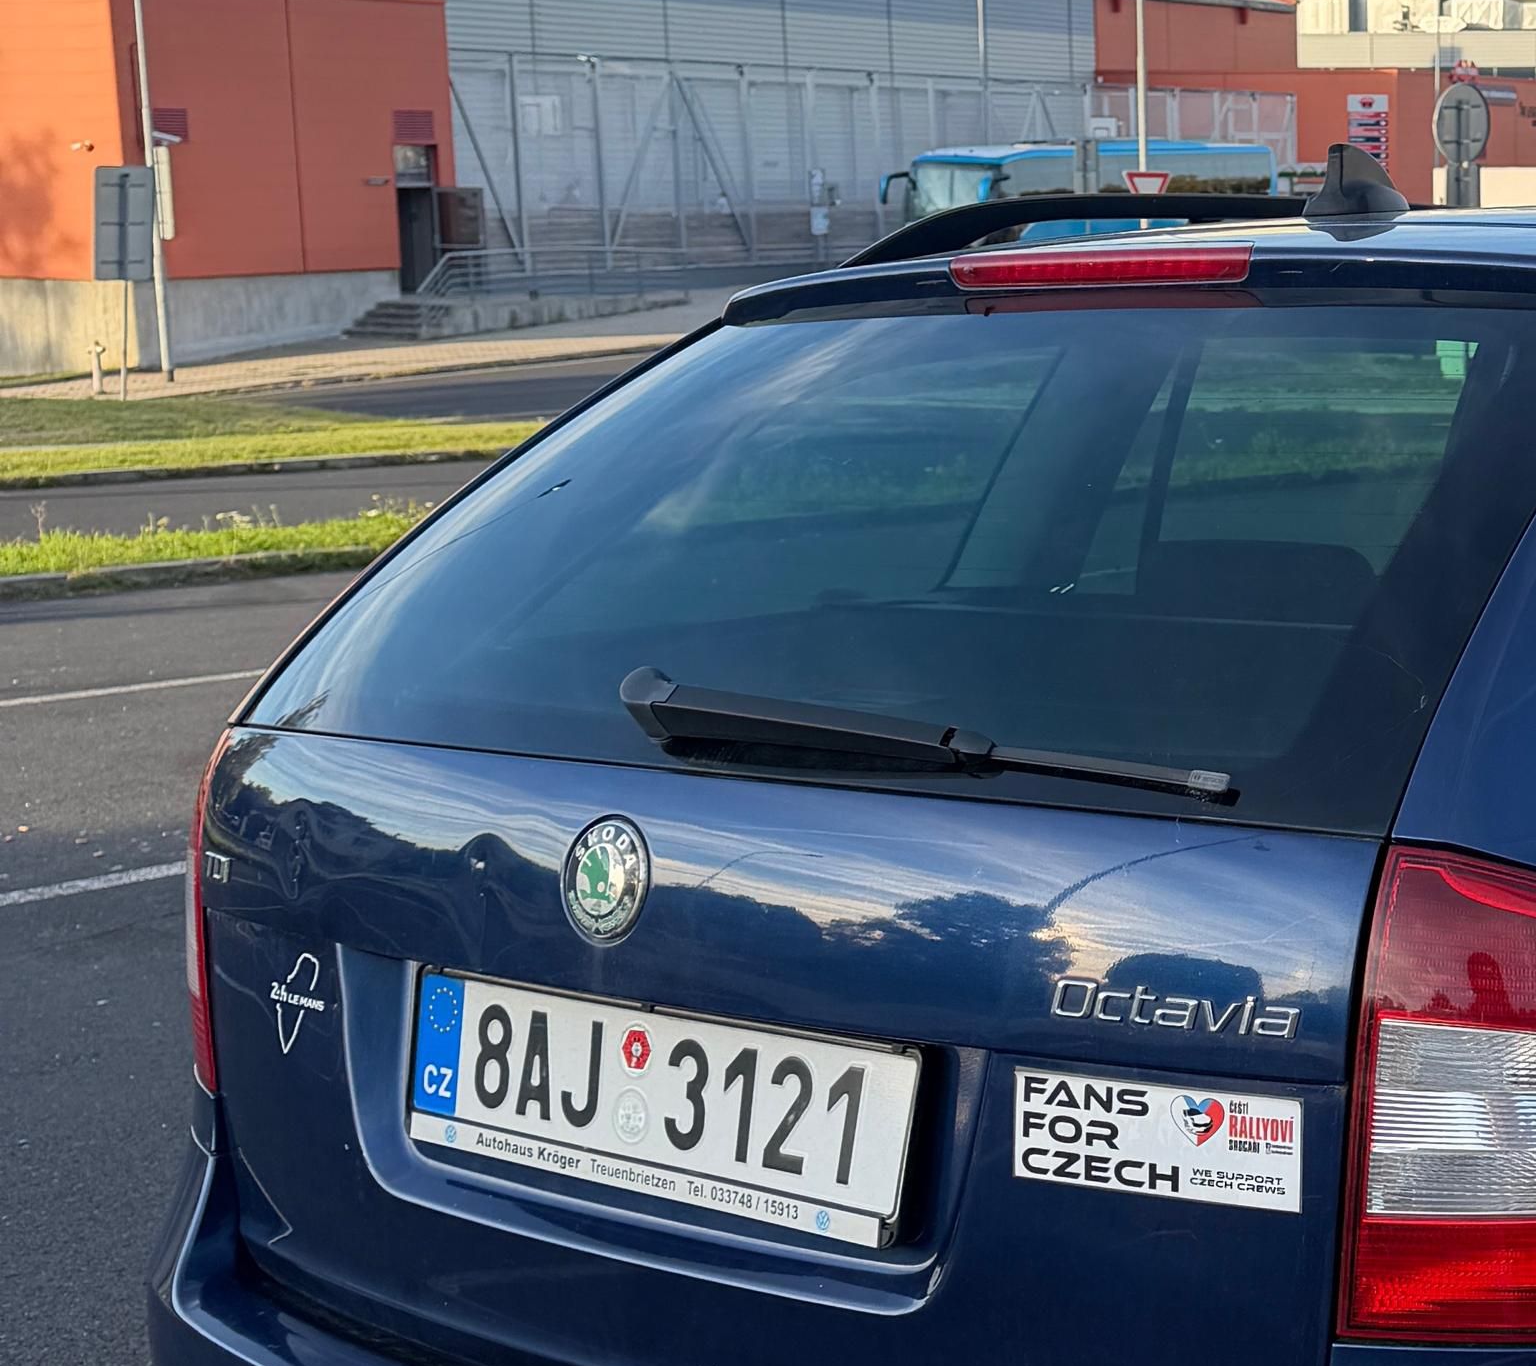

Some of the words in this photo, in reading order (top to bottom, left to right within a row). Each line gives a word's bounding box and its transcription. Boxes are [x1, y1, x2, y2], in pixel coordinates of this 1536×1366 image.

[1051, 977, 1302, 1040] Octavia
[422, 1064, 454, 1100] CZ
[474, 1002, 604, 1128] 8AJ
[663, 1037, 868, 1186] 3121
[1023, 1076, 1150, 1117] FANS
[1022, 1110, 1120, 1150] FOR
[1229, 1115, 1295, 1143] RALLYOVÍ
[476, 1132, 534, 1158] Autohaus
[537, 1146, 581, 1169] Kröger
[590, 1158, 676, 1192] Treuenbrietzen
[687, 1180, 707, 1198] Tel.
[710, 1186, 752, 1209] 033748
[763, 1198, 799, 1220] 15913
[1021, 1147, 1180, 1193] CZECH
[1189, 1177, 1233, 1190] CZECH
[1237, 1182, 1286, 1196] CREWS
[1192, 1168, 1212, 1178] WE
[1216, 1171, 1284, 1186] SUPPORT
